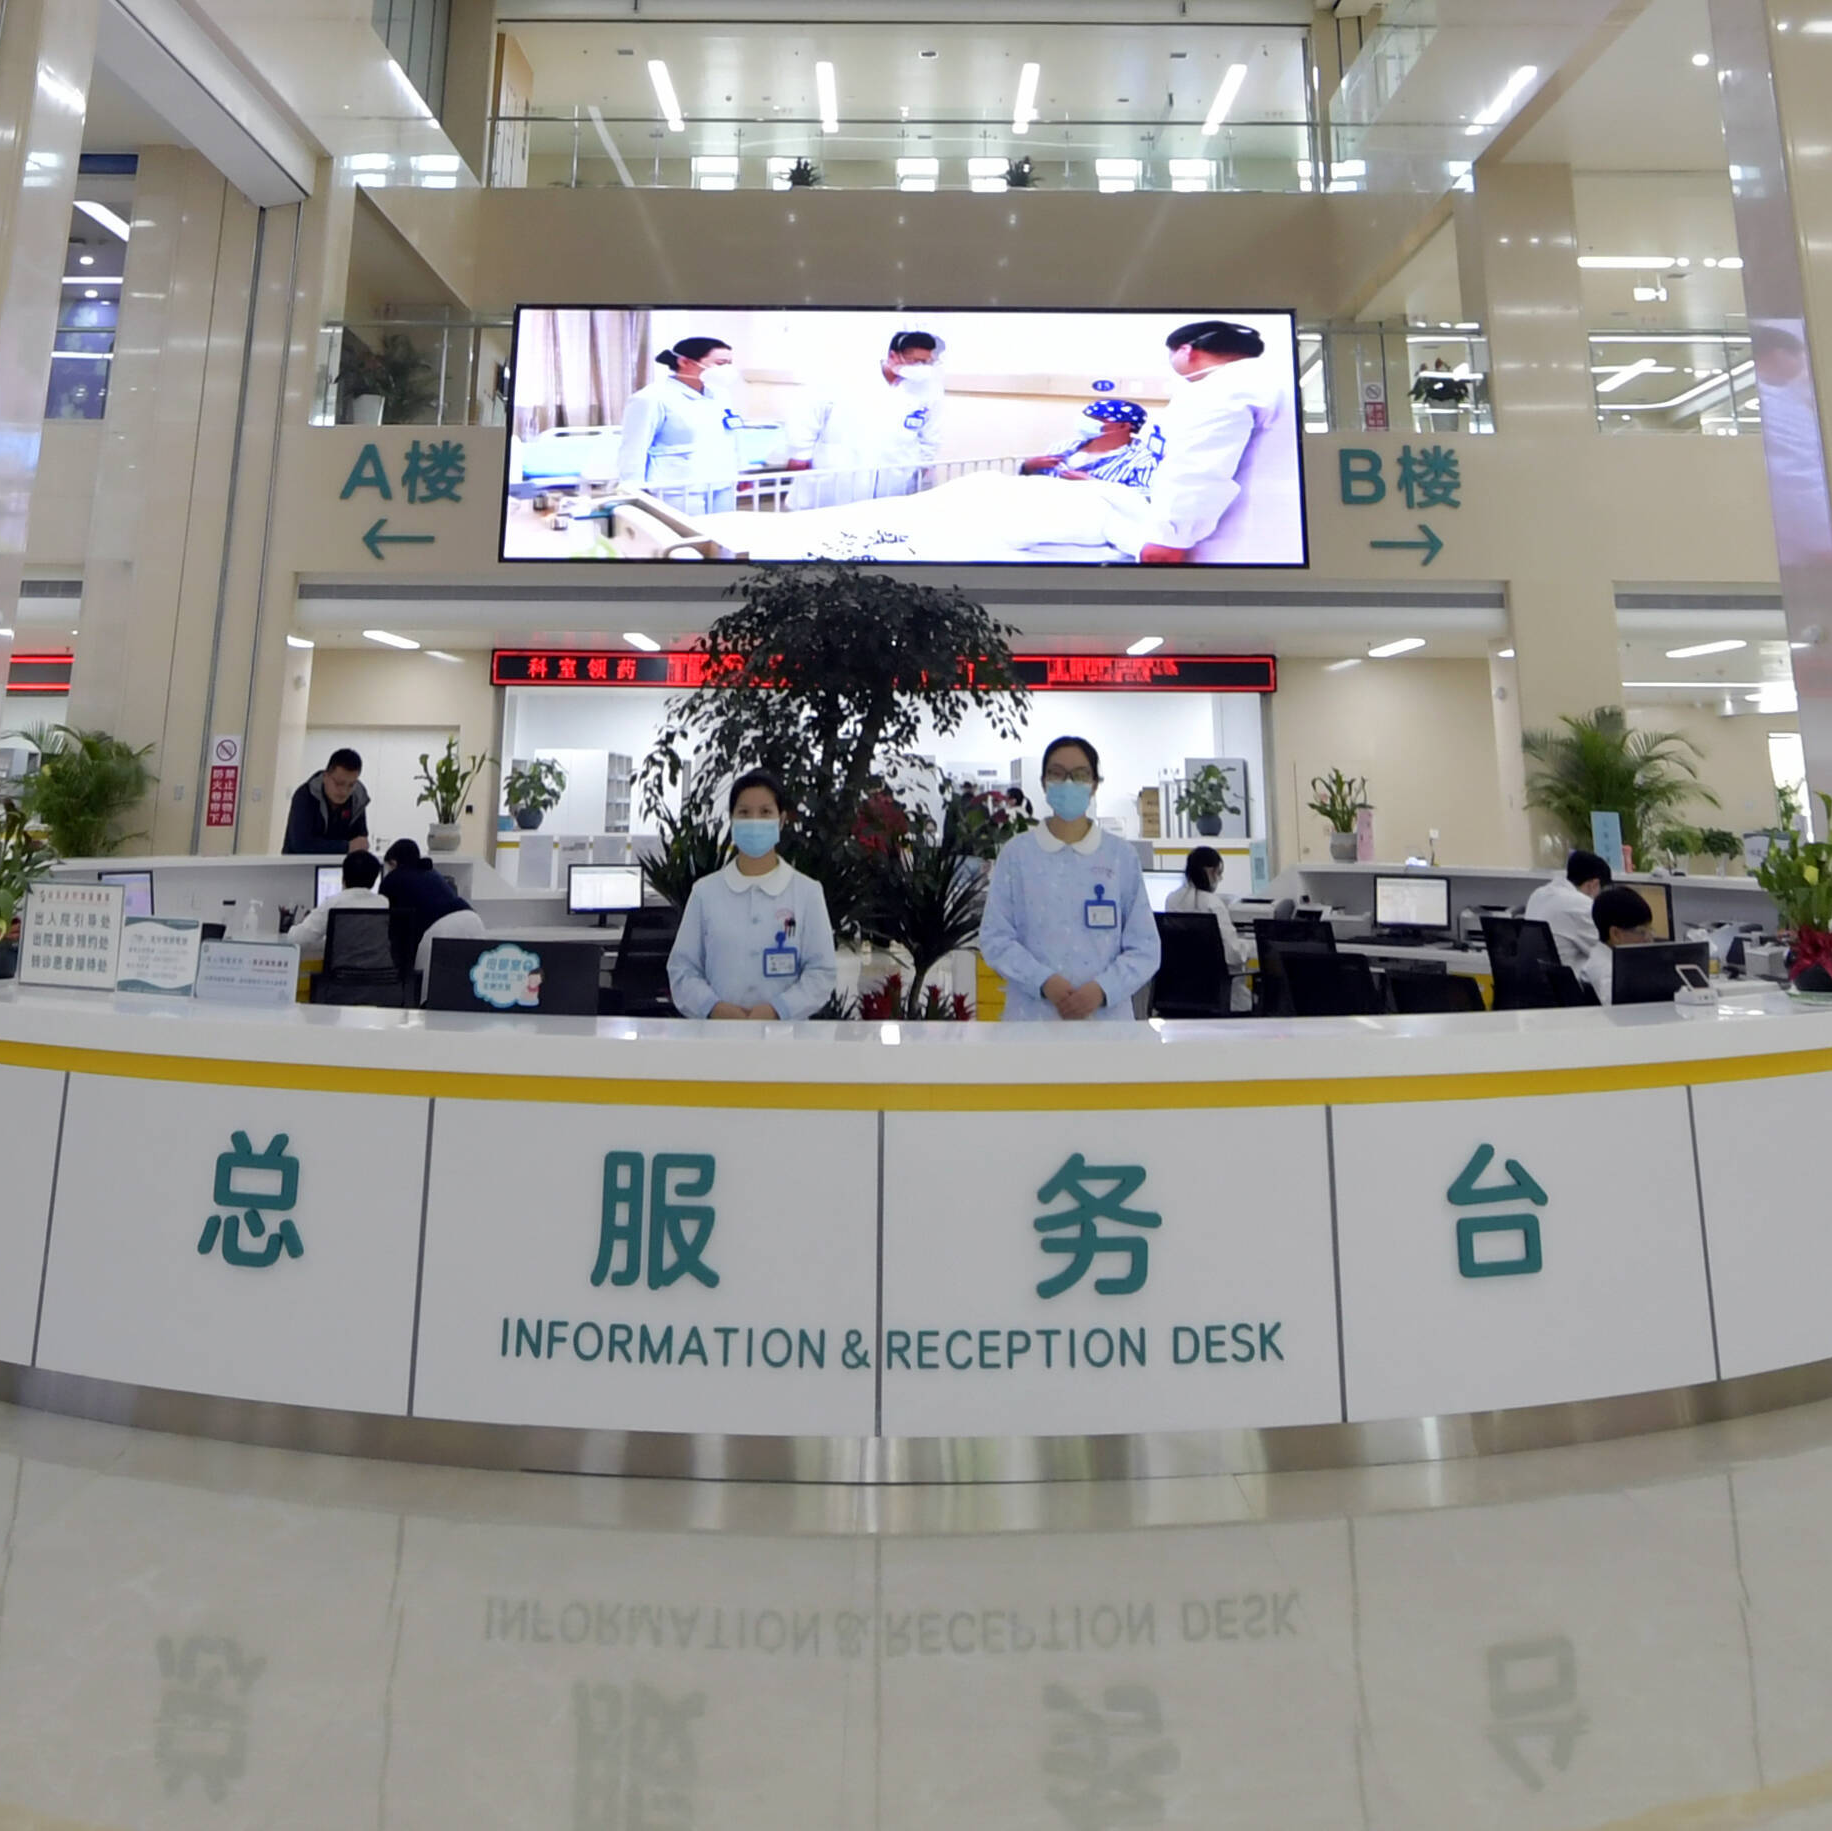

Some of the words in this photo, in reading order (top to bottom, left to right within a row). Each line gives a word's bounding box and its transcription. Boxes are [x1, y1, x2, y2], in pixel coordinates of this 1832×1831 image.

[340, 441, 464, 504] A楼
[1339, 445, 1461, 510] B楼
[527, 656, 638, 680] 科室领药
[198, 1130, 1548, 1299] 总服务台
[500, 1317, 826, 1370] INFORMATION
[840, 1330, 870, 1368] &
[885, 1326, 1147, 1370] RECEPTION
[1172, 1321, 1285, 1364] DESK
